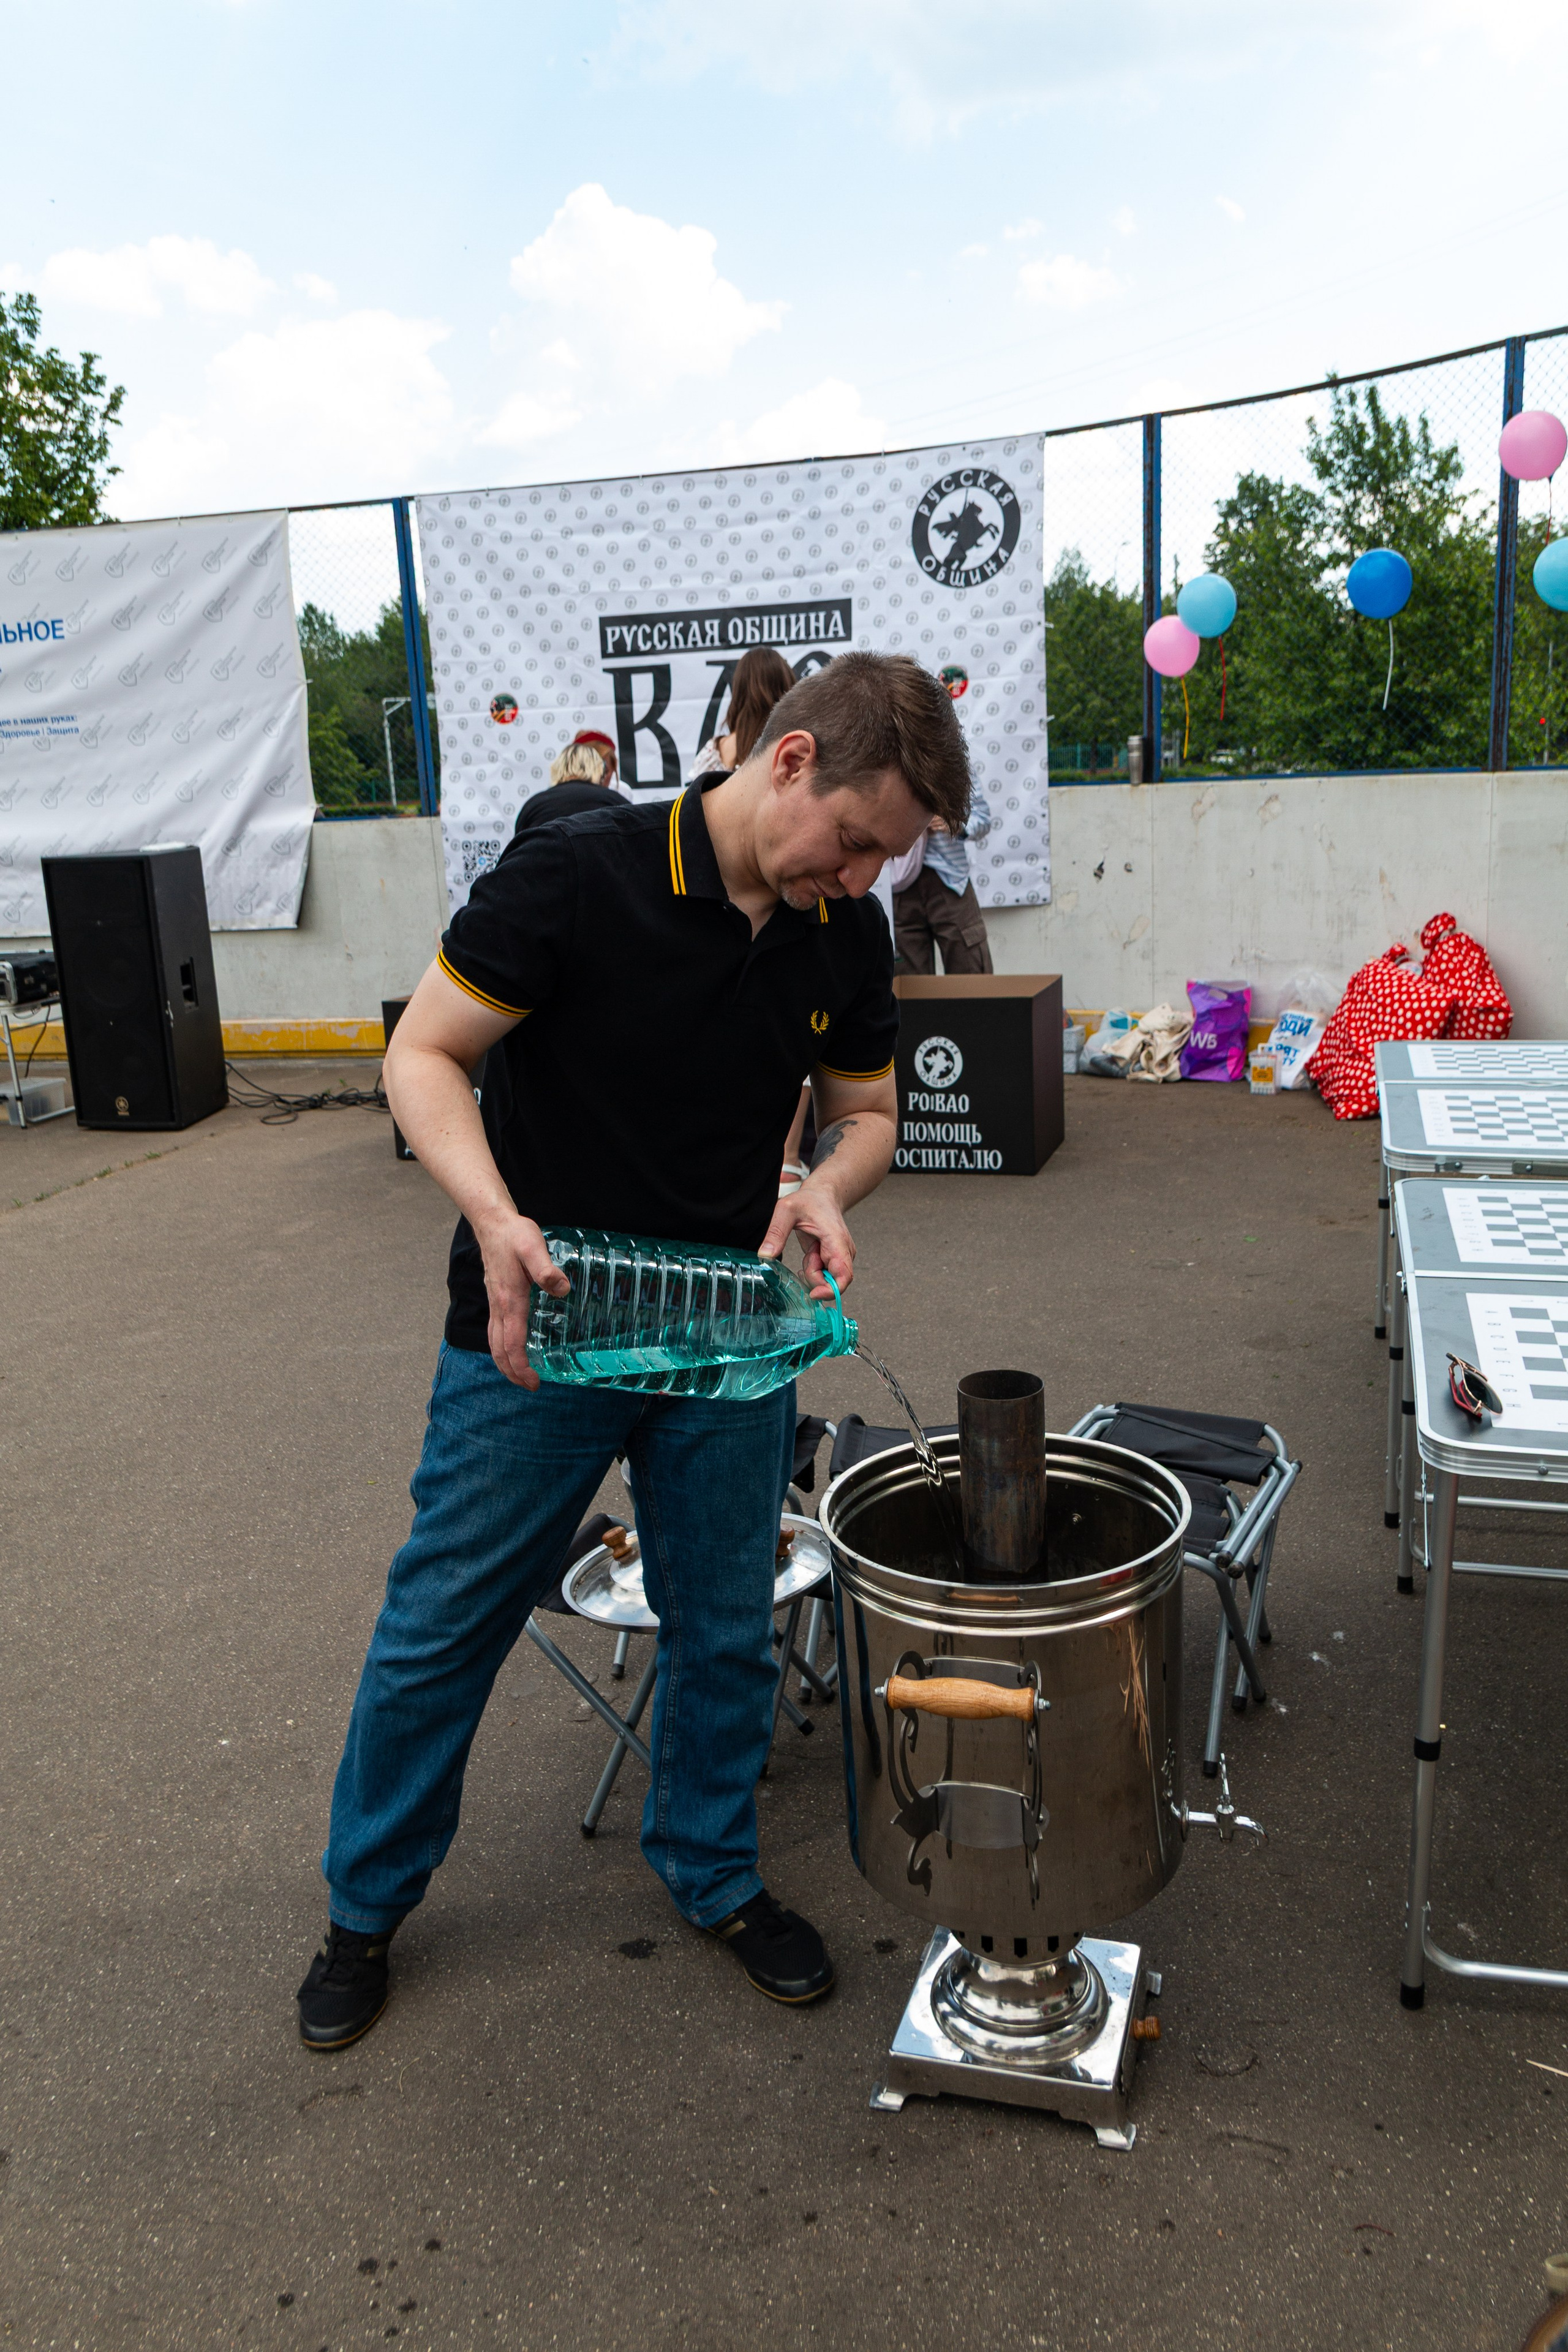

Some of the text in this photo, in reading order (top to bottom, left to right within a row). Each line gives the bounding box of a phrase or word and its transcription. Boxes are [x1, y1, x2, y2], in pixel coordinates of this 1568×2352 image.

[918, 469, 1014, 517] РУССКАЯ
[922, 546, 1010, 587] ОБЩИНА
[0, 619, 64, 644] ЬНОЕ
[605, 609, 846, 654] РУССКАЯ ОБЩИНА
[903, 1121, 982, 1148] ПОМОЩЬ
[895, 1148, 1003, 1170] ОСПИТАЛЮ
